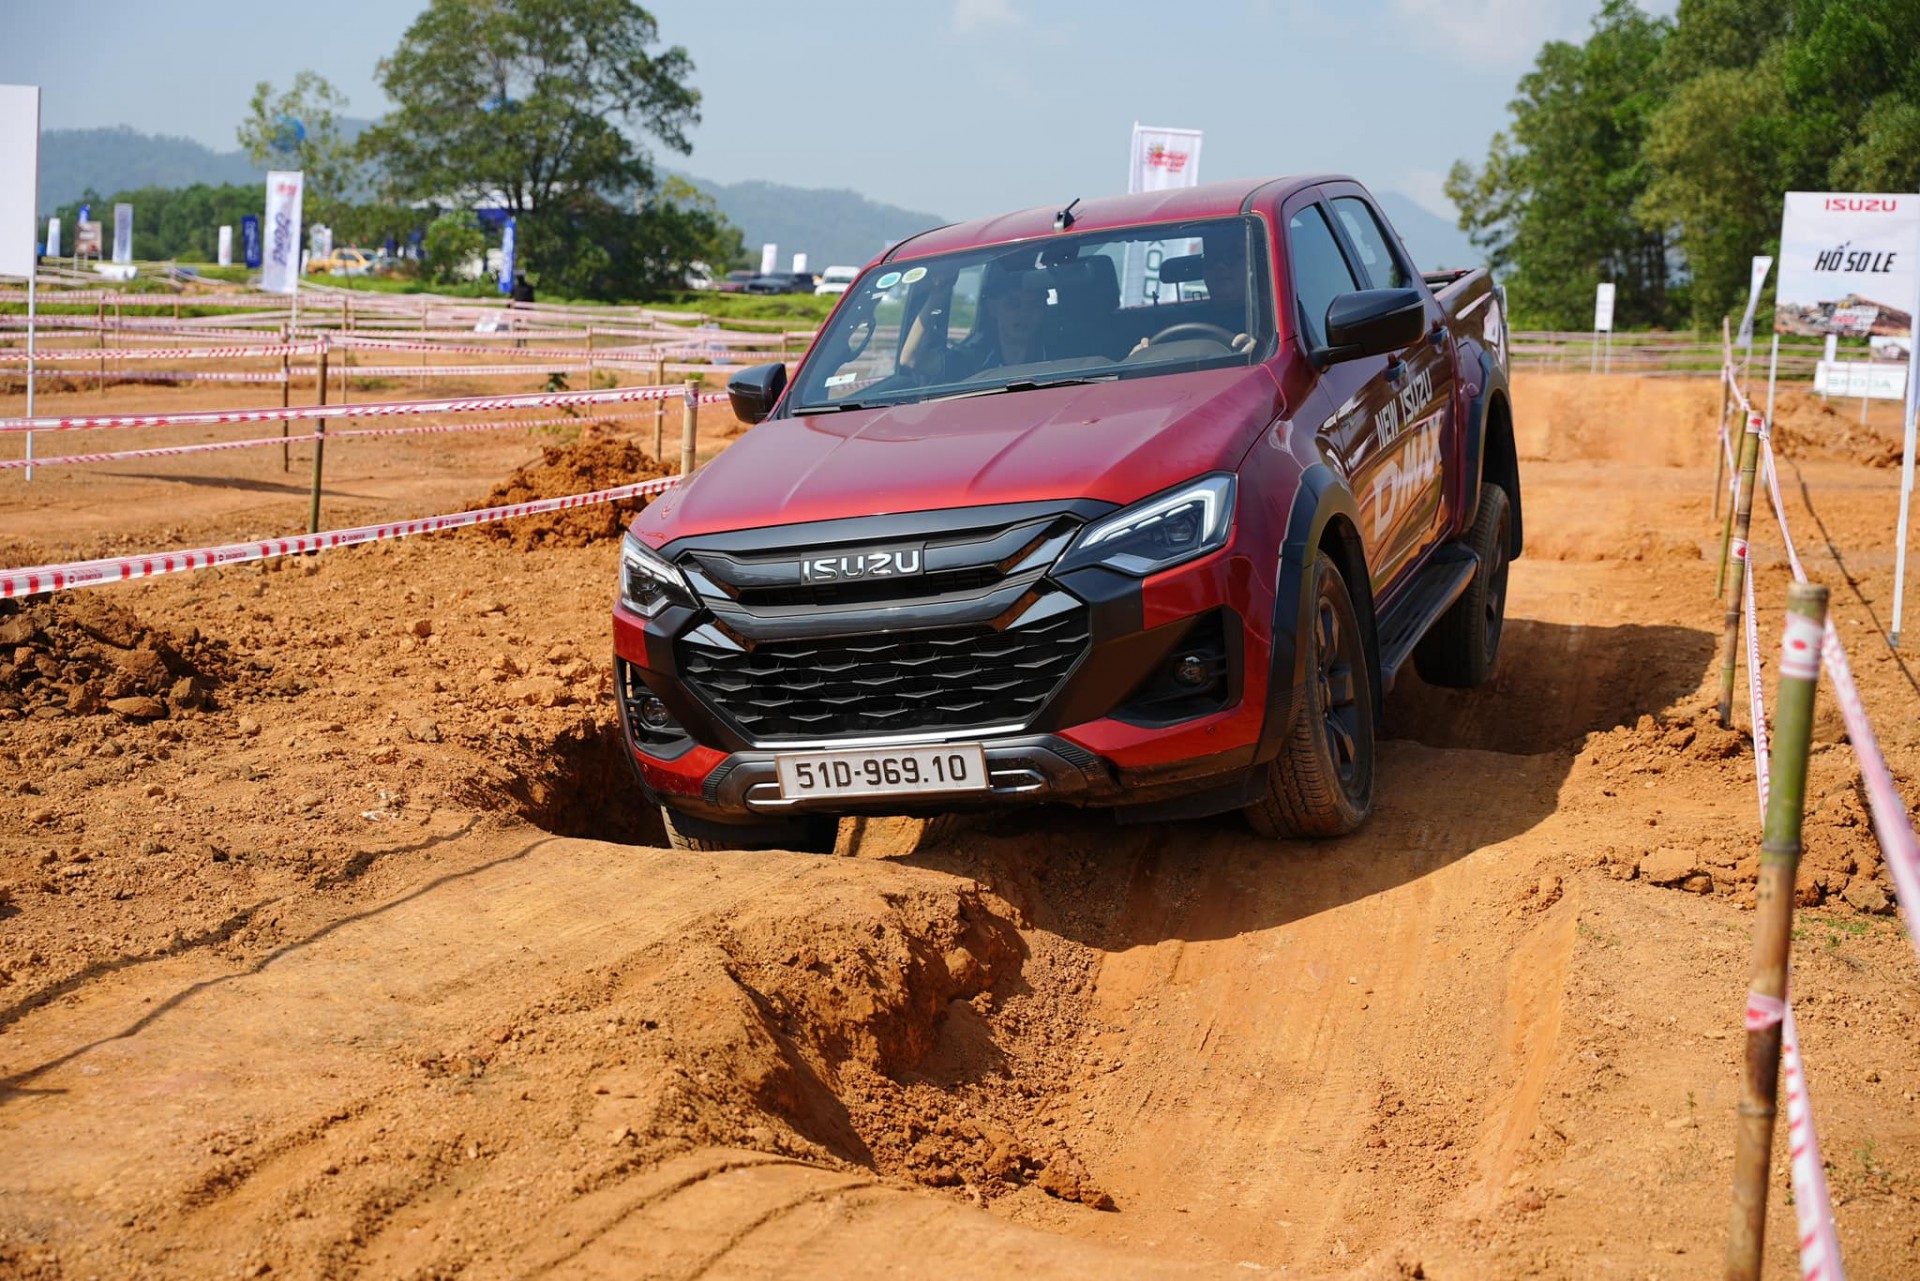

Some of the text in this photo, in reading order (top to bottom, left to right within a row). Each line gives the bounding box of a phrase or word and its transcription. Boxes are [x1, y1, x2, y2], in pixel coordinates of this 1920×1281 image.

[1825, 198, 1897, 212] ISUZU
[1872, 252, 1897, 273] LE
[1374, 367, 1433, 451] NEW ISUZU
[802, 549, 920, 583] ISUZU
[795, 754, 967, 790] 51D-969.10
